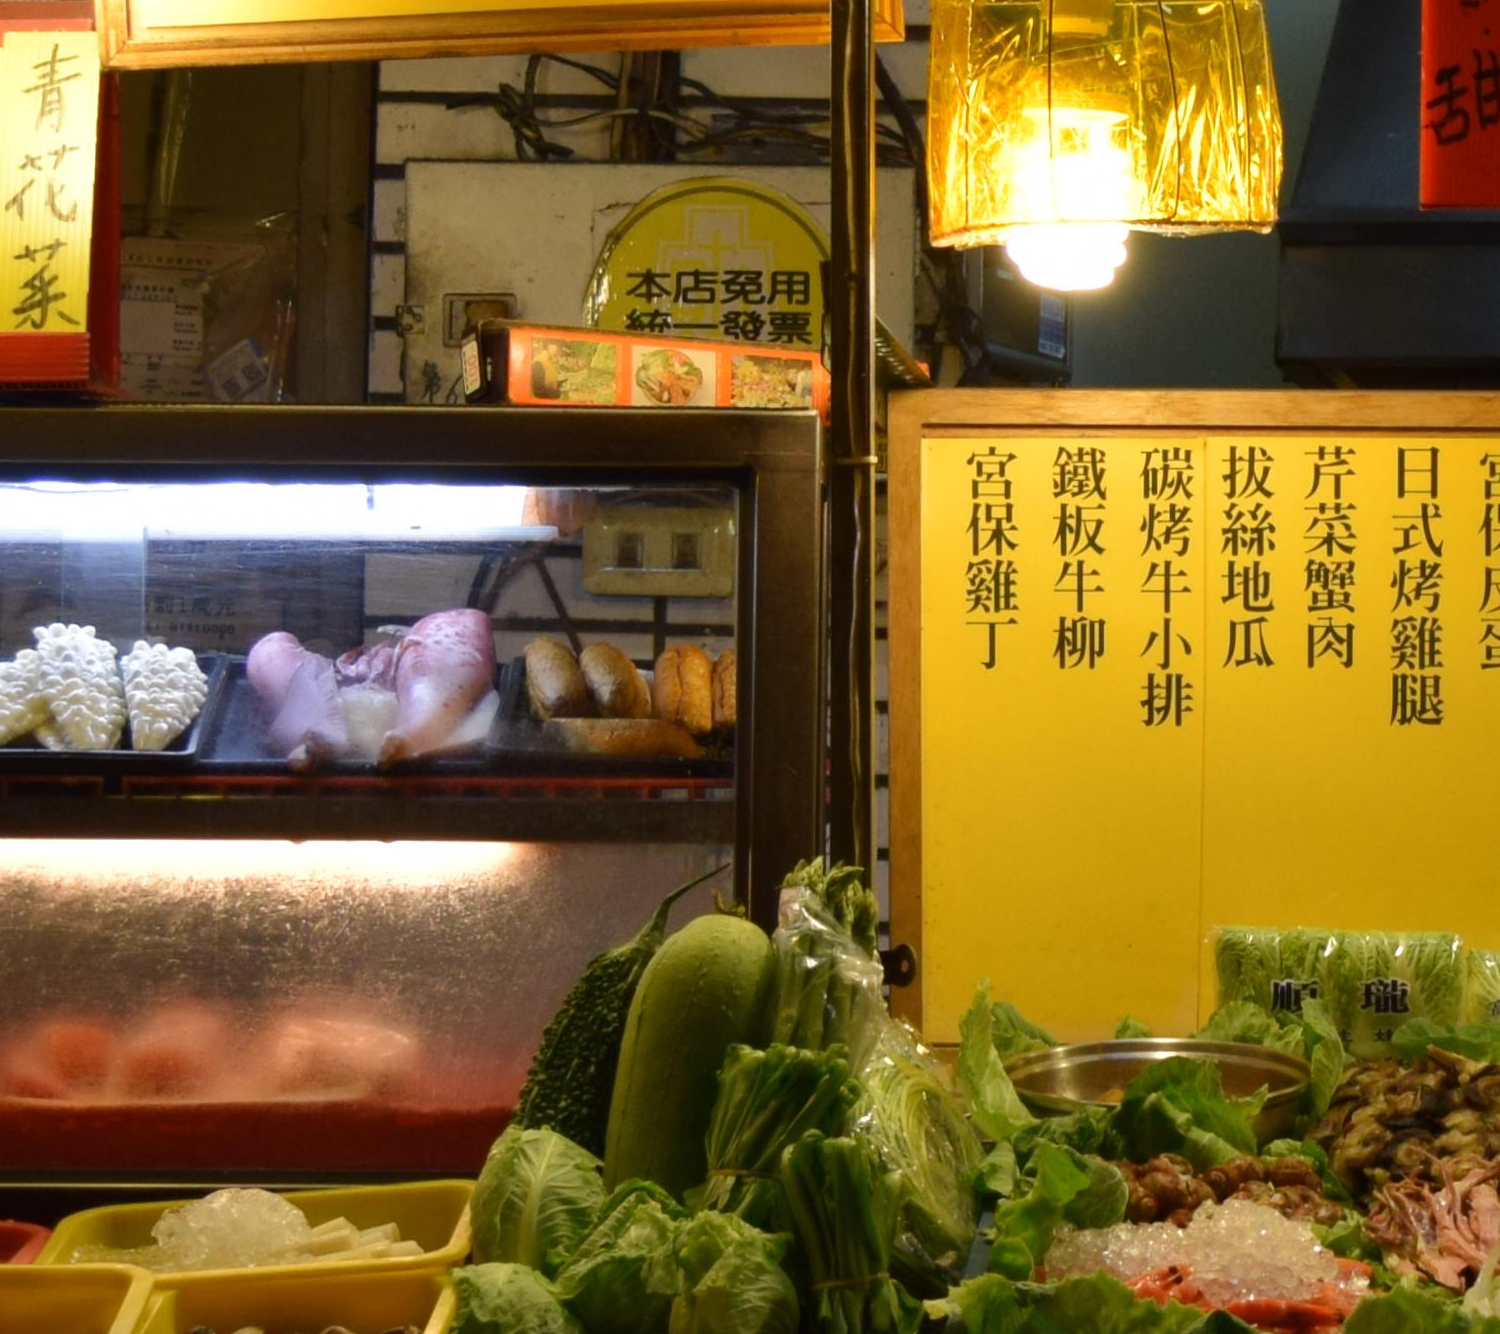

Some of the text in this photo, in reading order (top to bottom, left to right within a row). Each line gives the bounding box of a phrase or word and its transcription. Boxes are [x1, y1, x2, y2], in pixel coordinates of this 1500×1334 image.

[5, 43, 83, 332] 青花菜
[626, 268, 811, 305] 本店免用
[626, 309, 813, 345] 統一發票
[964, 446, 1019, 669] 宮保雞丁
[1052, 446, 1107, 670] 鐵板牛柳
[1139, 446, 1194, 728] 碳烤牛小排
[1220, 446, 1277, 670] 拔絲地瓜
[1302, 446, 1358, 670] 芹菜蟹肉
[1389, 446, 1444, 728] 日式烤雞腿
